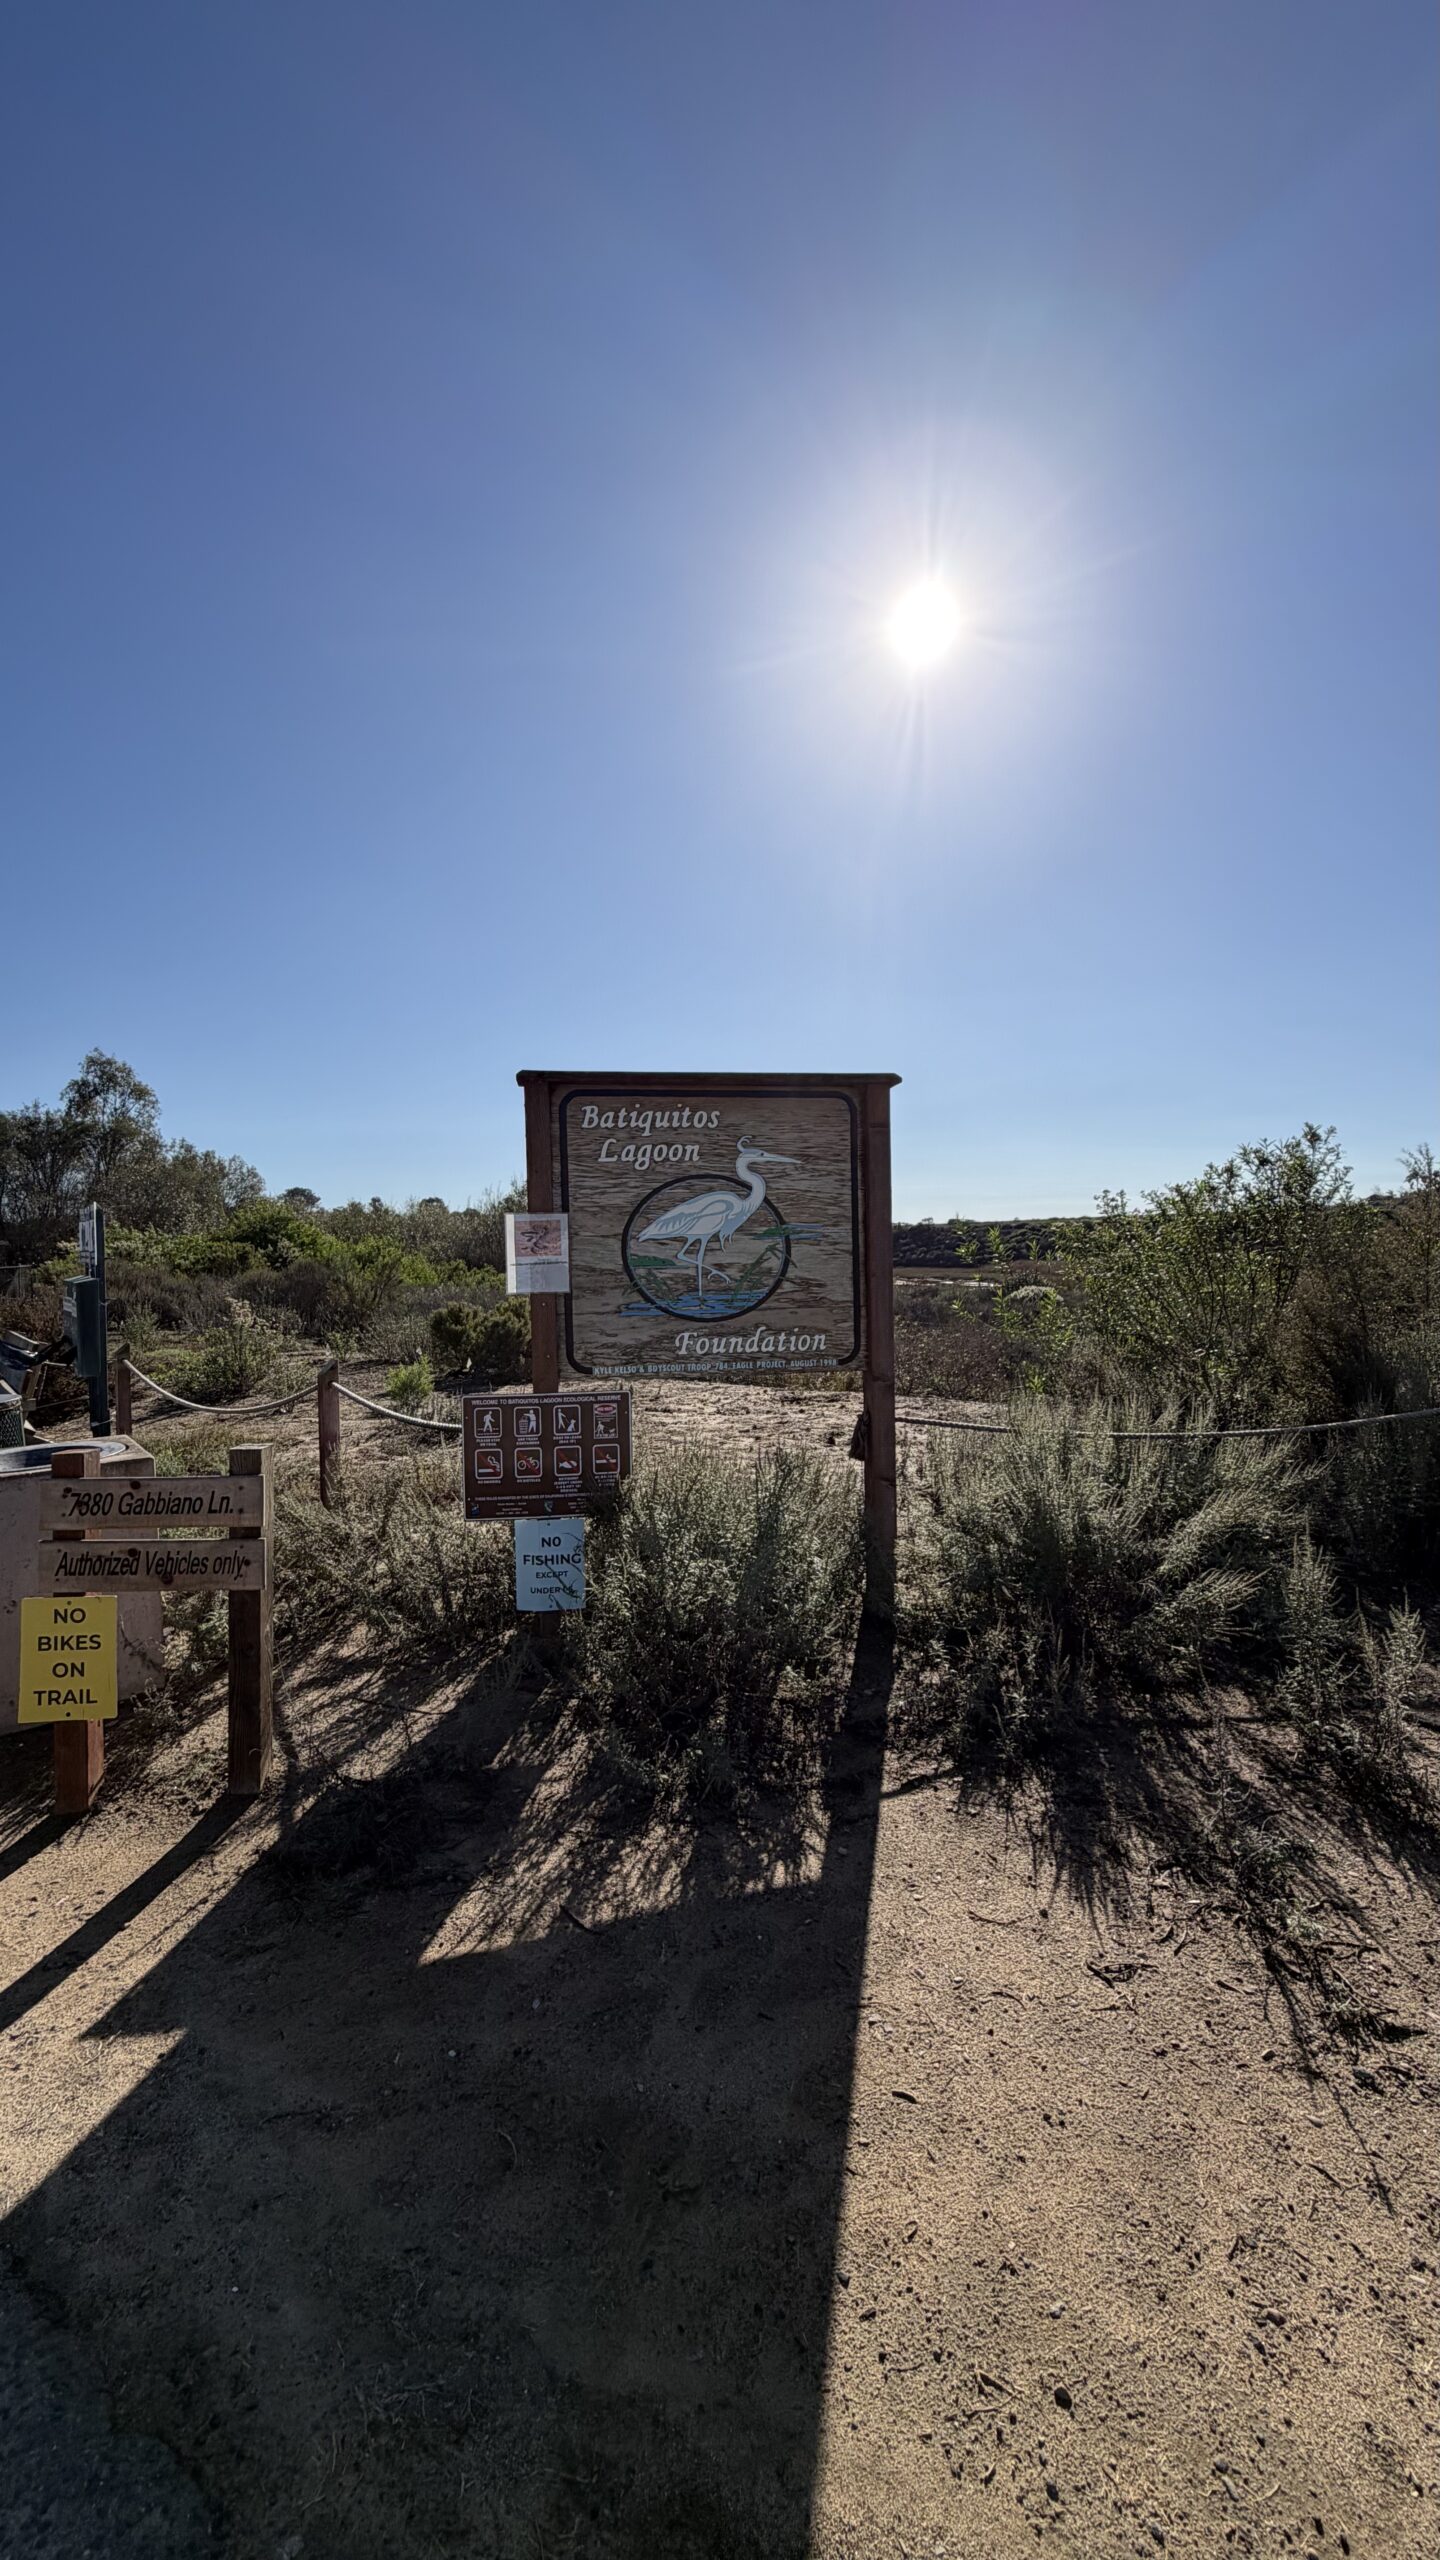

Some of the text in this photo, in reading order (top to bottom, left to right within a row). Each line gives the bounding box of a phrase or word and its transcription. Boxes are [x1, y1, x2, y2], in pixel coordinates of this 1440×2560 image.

[581, 1104, 721, 1137] Batiquitos
[598, 1138, 700, 1170] Lagoon
[675, 1326, 827, 1355] Foundation
[594, 1366, 612, 1375] KYLE
[614, 1365, 637, 1374] KELSO
[647, 1364, 685, 1373] BOYSCOUT
[687, 1363, 711, 1371] TROOP
[733, 1361, 753, 1369] EAGLE
[790, 1359, 817, 1367] AUGUST
[68, 1490, 234, 1516] 7380 Gabbiano Ln.
[541, 1536, 562, 1548] NO
[54, 1550, 245, 1581] Authorized Vehicles only
[523, 1553, 582, 1566] FISHING
[535, 1571, 568, 1579] EXCEPT
[530, 1586, 561, 1594] UNDER
[53, 1607, 87, 1624] NO
[37, 1634, 102, 1651] BIKES
[52, 1661, 85, 1678] ON
[33, 1688, 98, 1706] TRAIL
